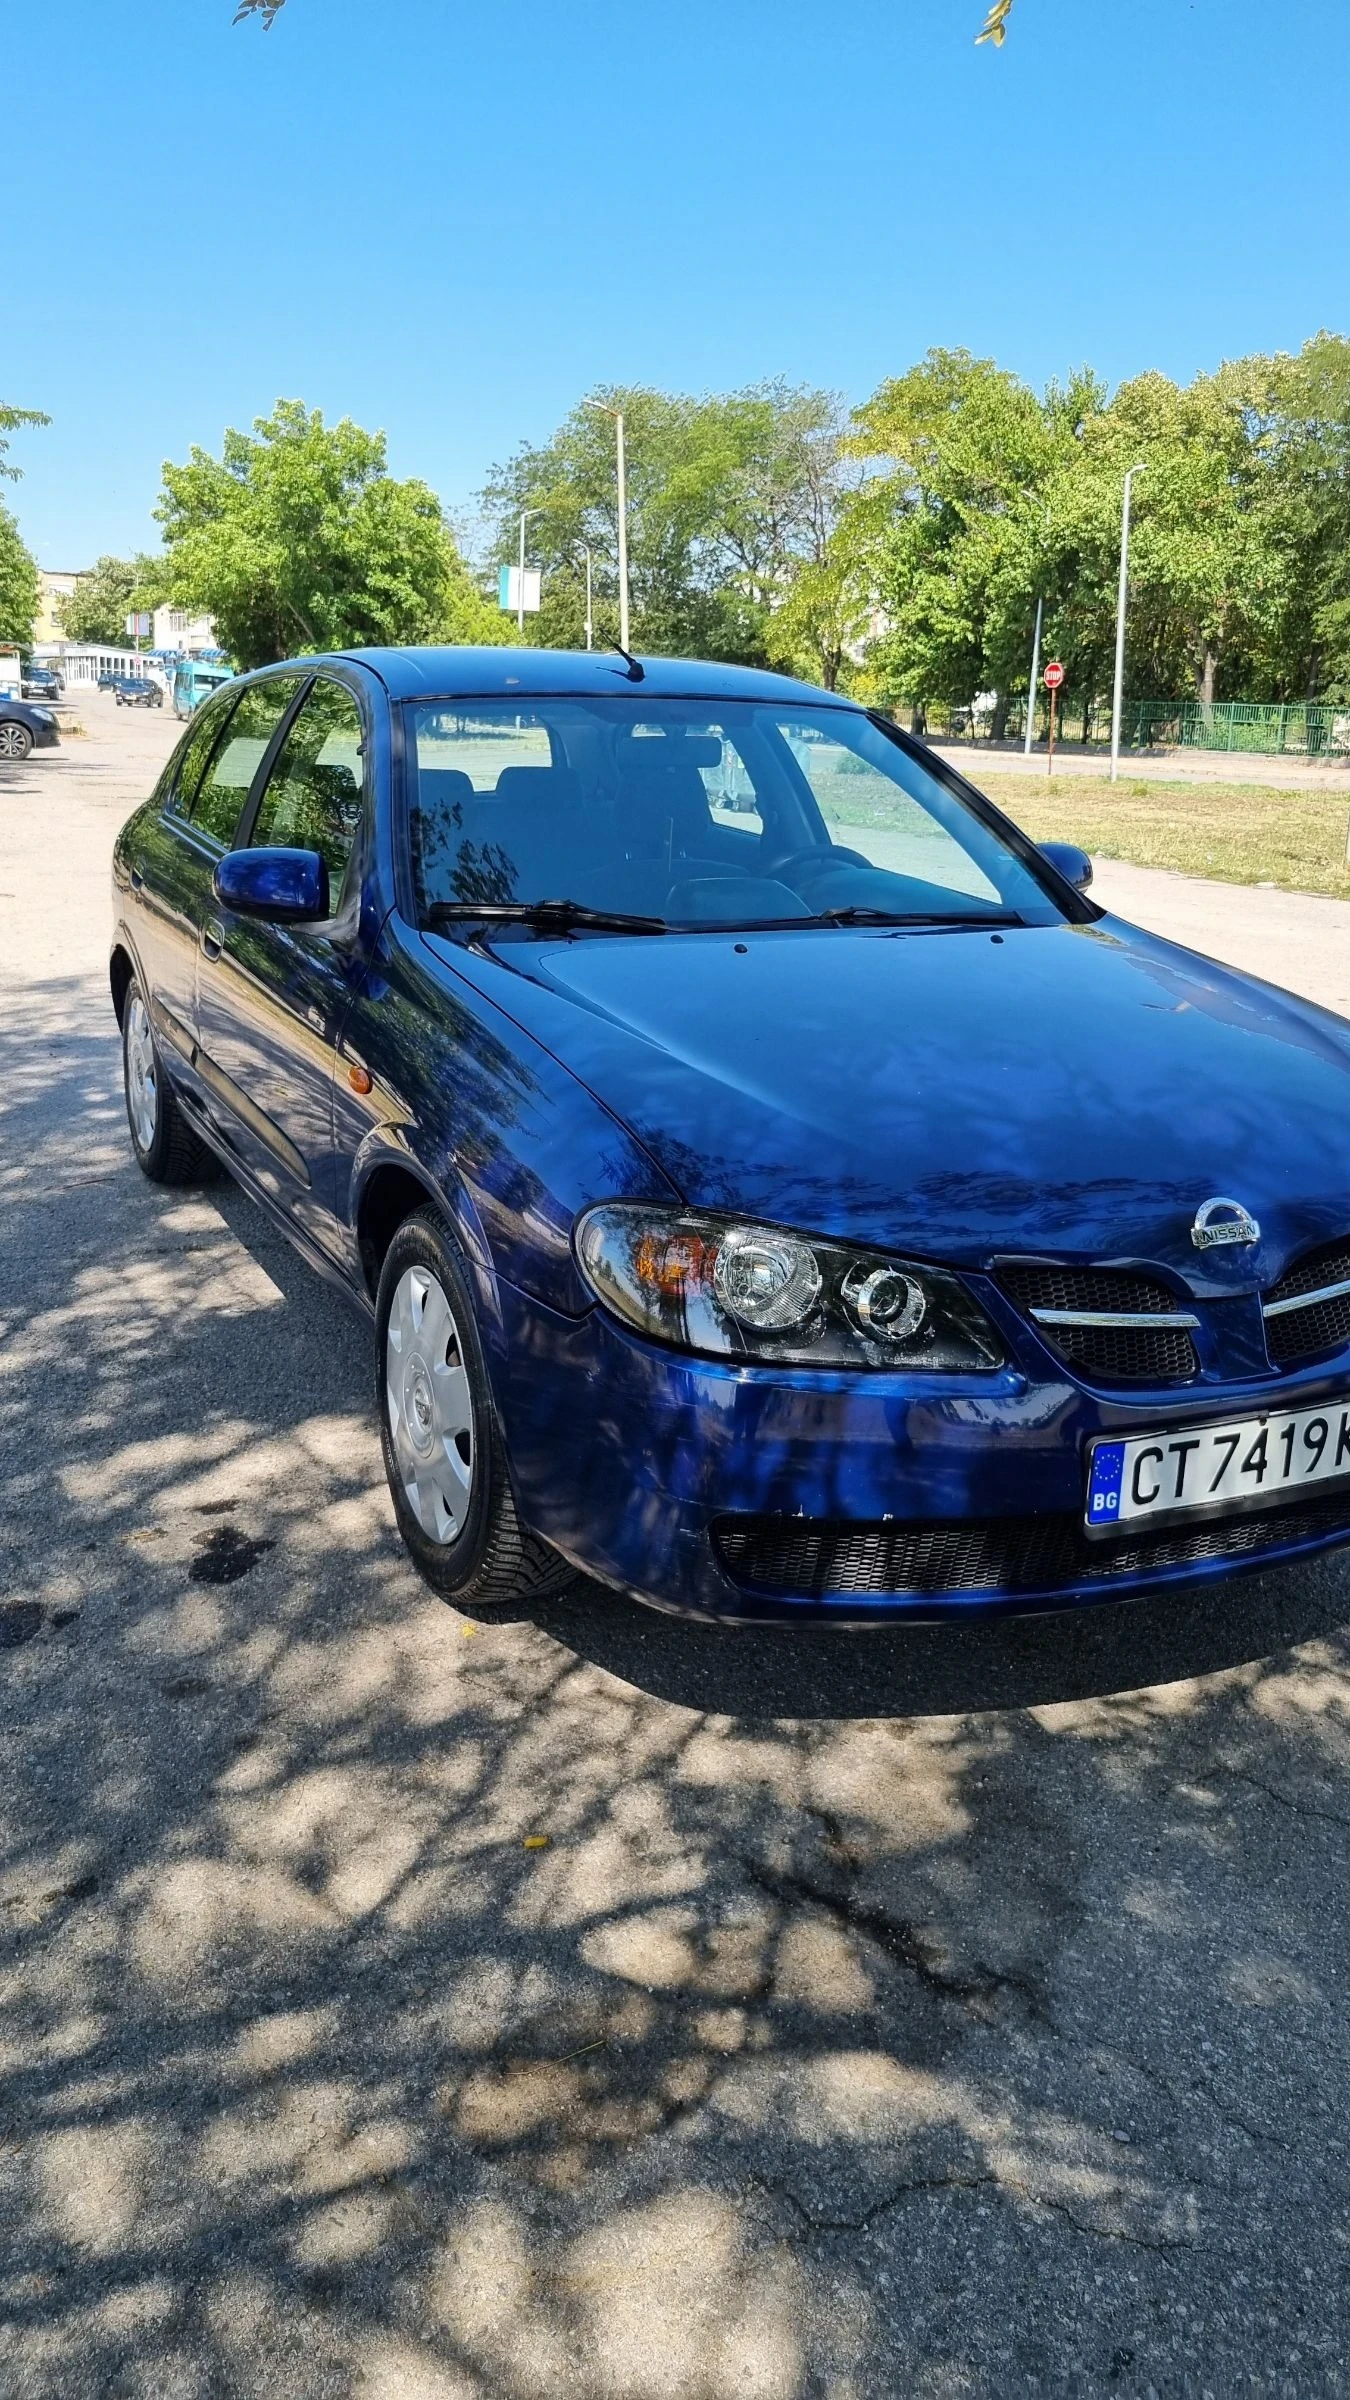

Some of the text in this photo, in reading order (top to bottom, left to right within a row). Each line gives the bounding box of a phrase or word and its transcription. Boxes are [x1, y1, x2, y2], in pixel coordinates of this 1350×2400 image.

[1046, 671, 1060, 680] STOP
[1201, 1224, 1257, 1242] NISSAN
[1131, 1439, 1200, 1506] CT
[1093, 1491, 1117, 1511] BG
